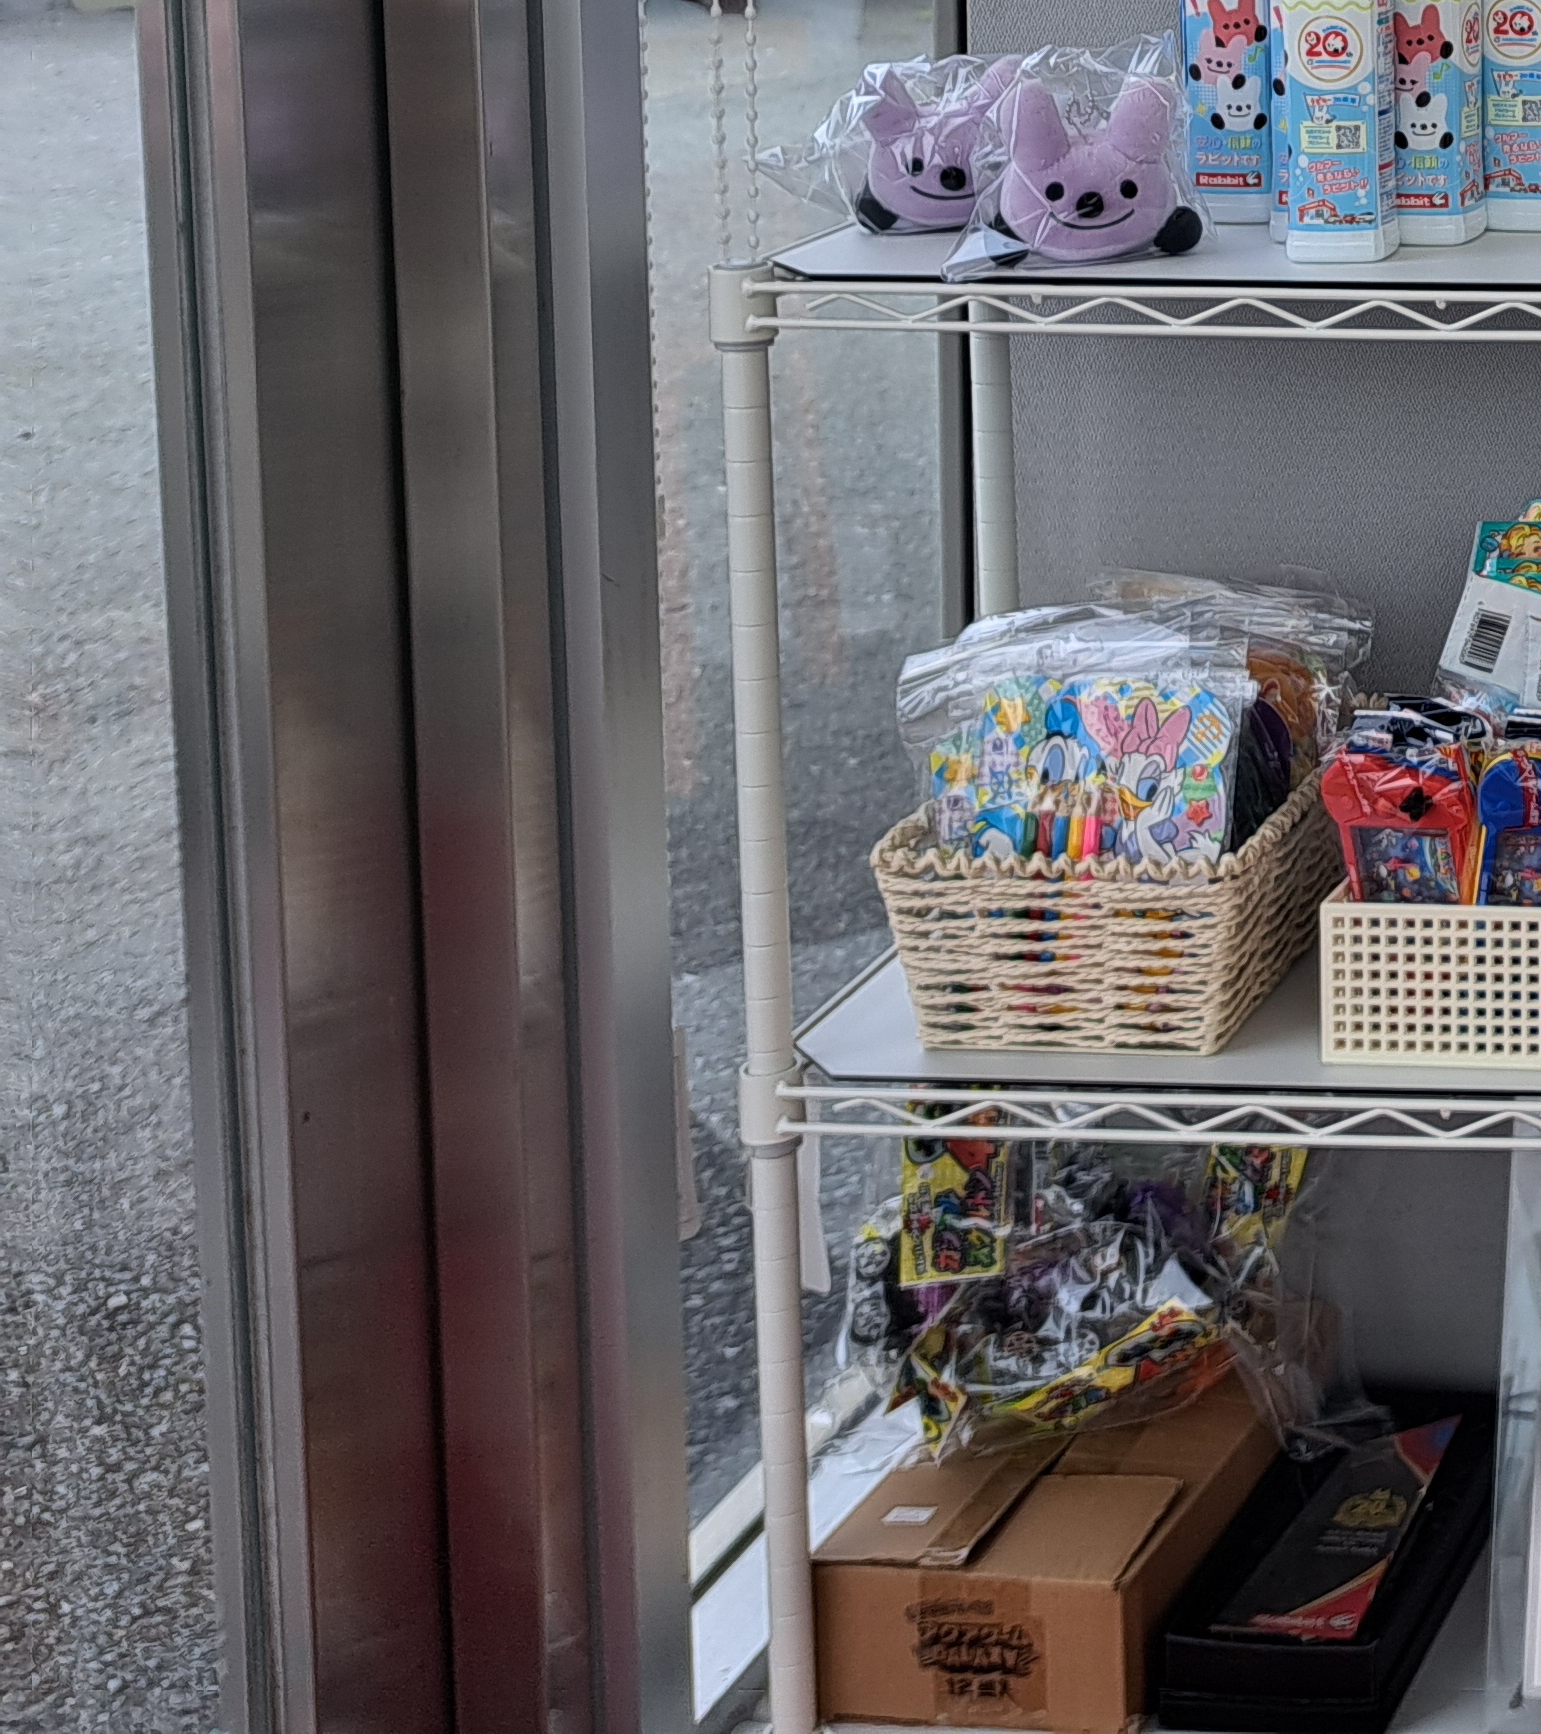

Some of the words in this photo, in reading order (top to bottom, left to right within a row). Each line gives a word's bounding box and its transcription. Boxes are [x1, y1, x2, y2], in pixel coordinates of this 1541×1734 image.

[1196, 155, 1261, 166] ラビットです
[1199, 175, 1244, 185] Rabbit
